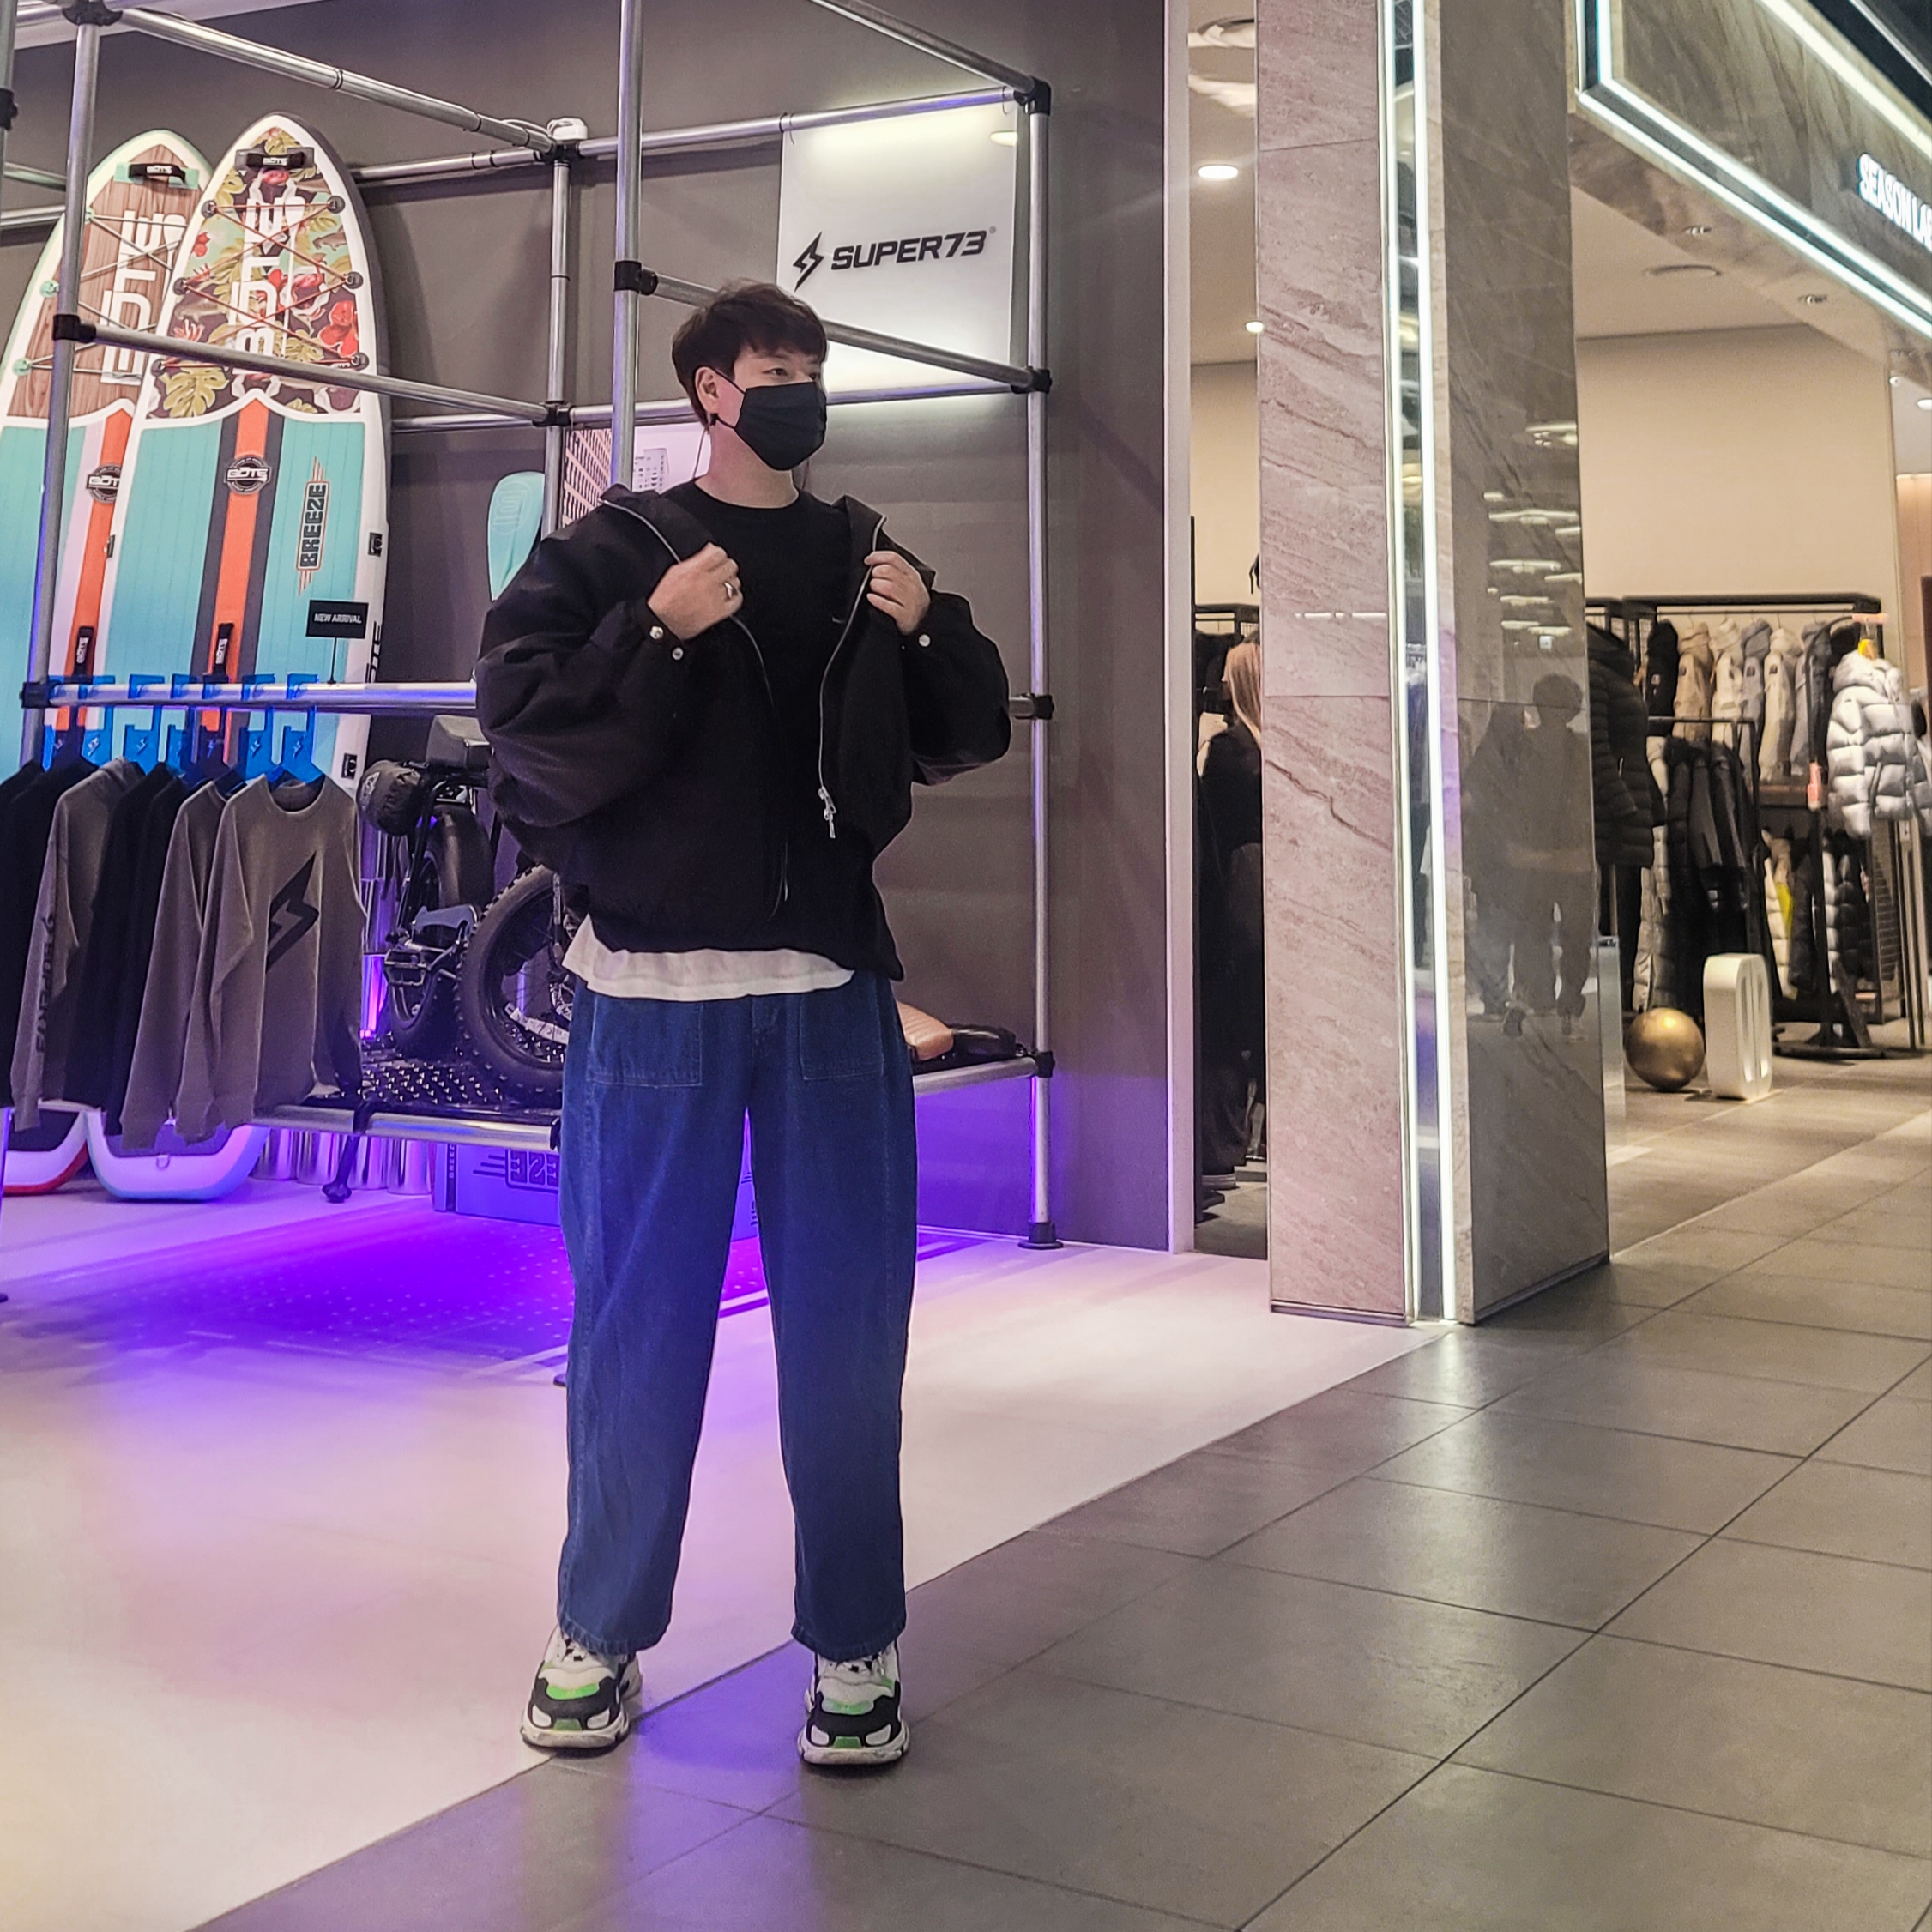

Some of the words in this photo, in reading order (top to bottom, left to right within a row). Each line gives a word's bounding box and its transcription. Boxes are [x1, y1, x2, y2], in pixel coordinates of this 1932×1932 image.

[1859, 154, 1911, 235] SEASON
[830, 229, 987, 270] SUPER73
[299, 485, 327, 567] BREEZE
[314, 613, 331, 623] NEW
[332, 613, 362, 624] ARRIVAL
